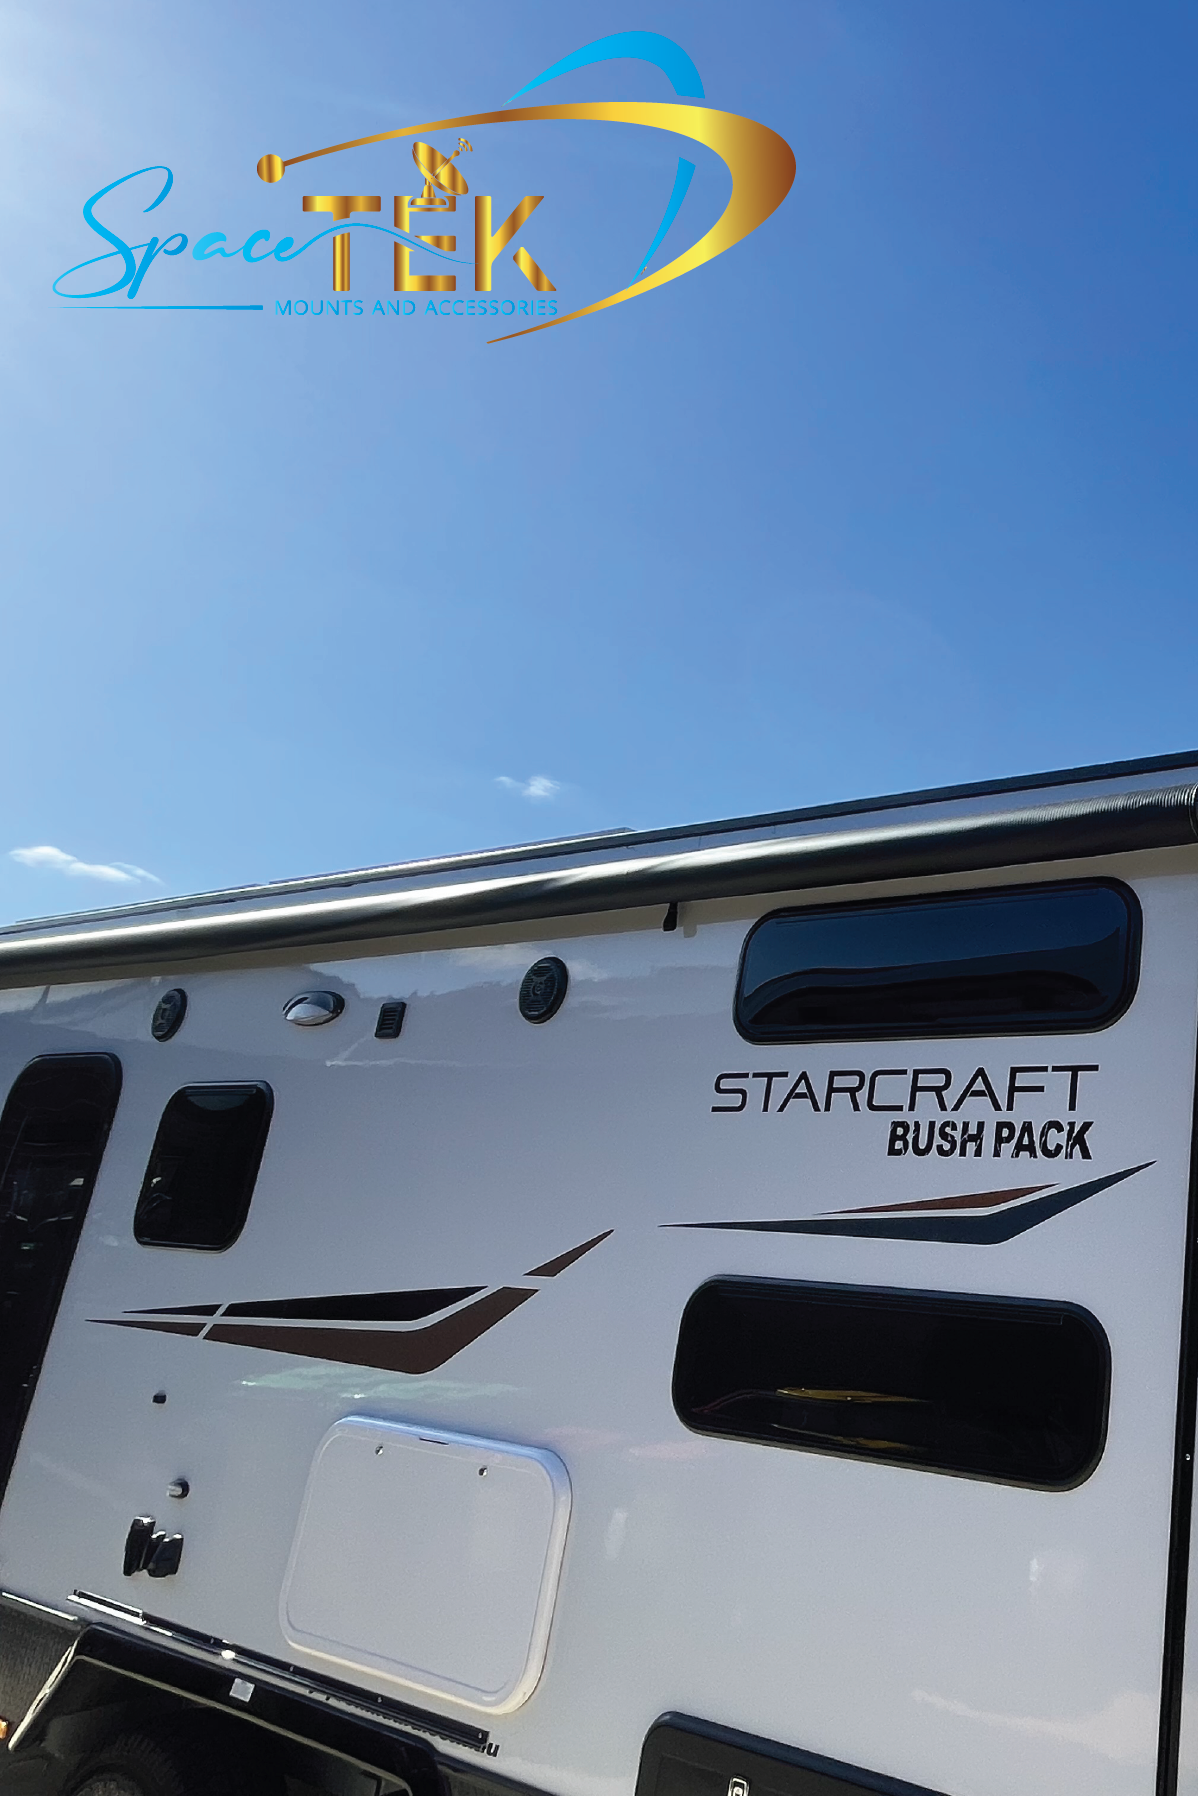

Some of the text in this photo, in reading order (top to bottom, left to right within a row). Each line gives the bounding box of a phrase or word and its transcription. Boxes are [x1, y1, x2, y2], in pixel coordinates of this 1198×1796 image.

[710, 1064, 1100, 1113] STARCRAFT
[887, 1120, 1095, 1160] BUSH PACK
